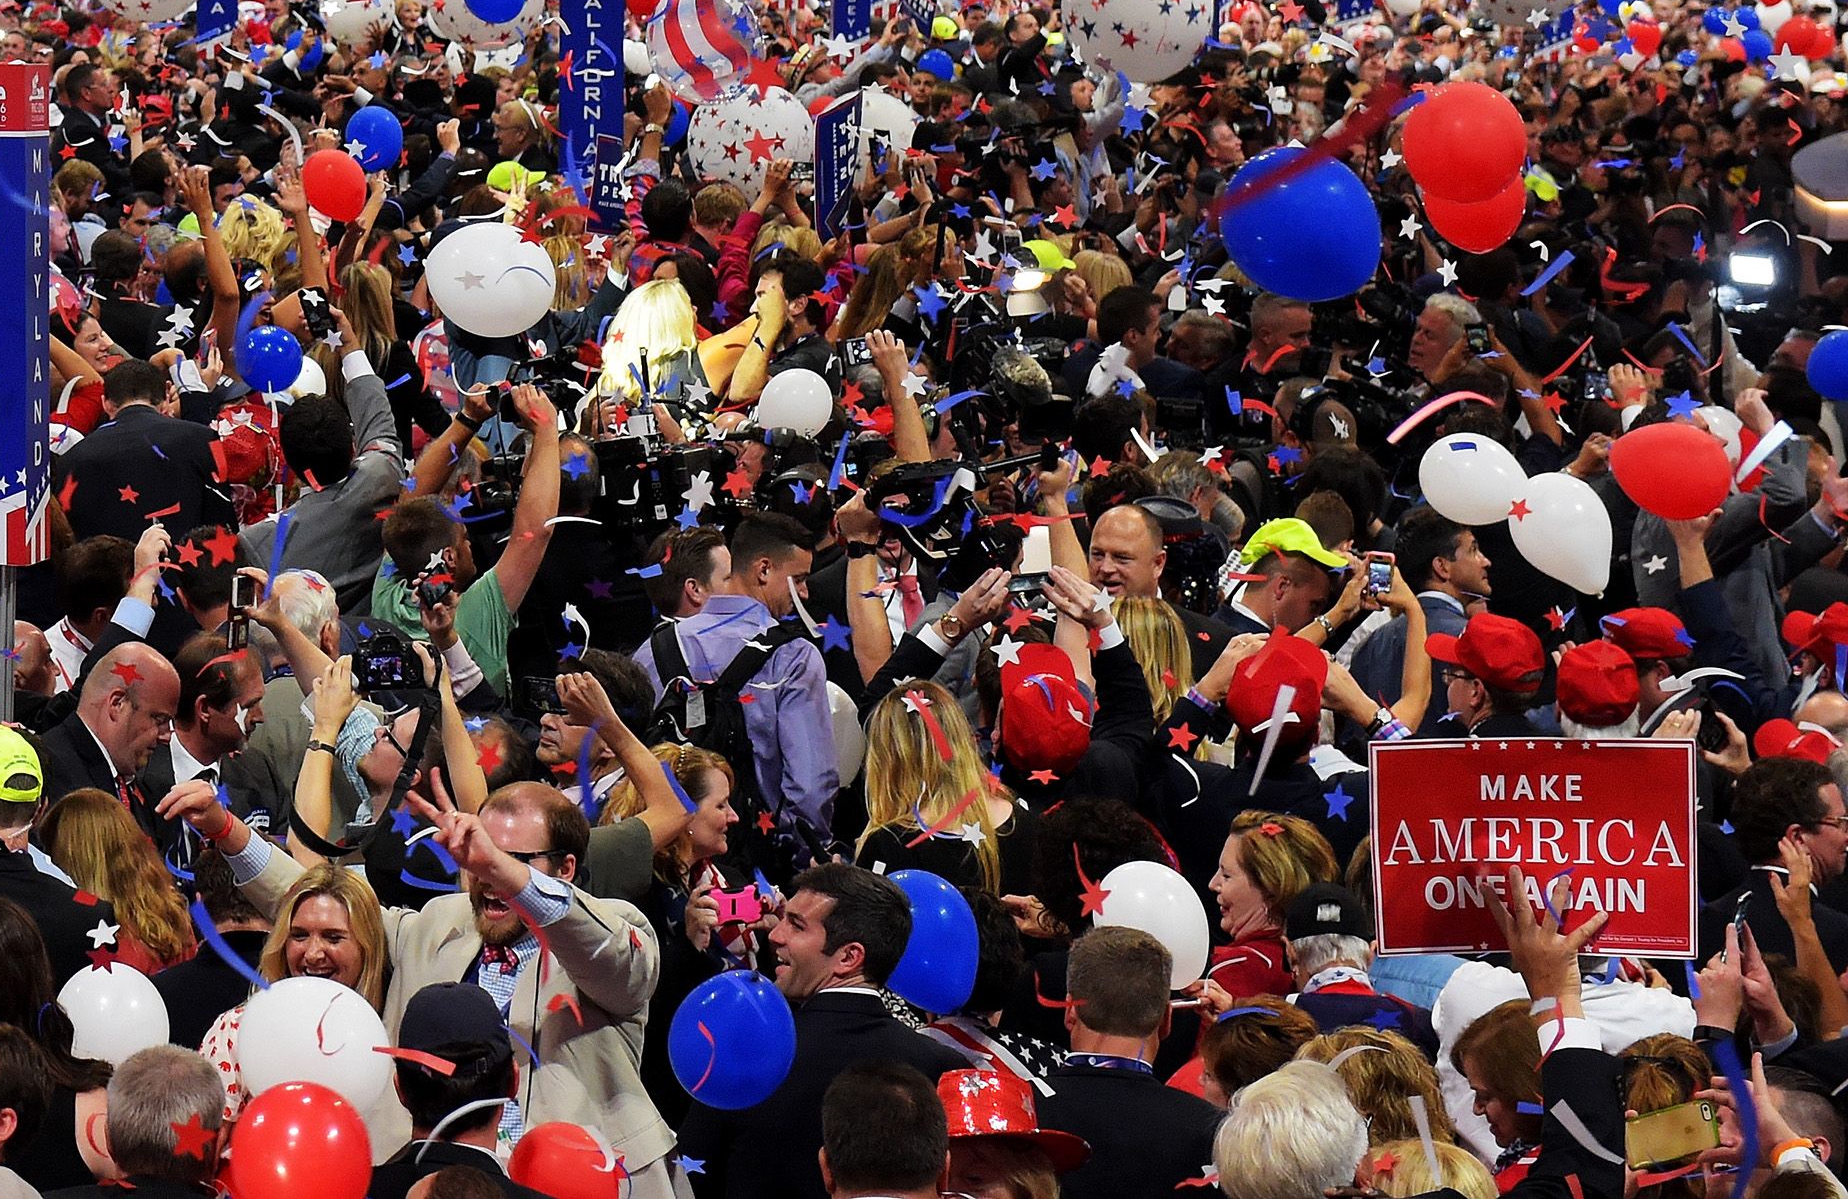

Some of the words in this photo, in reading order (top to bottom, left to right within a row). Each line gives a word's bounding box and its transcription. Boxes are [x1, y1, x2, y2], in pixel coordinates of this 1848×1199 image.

[32, 148, 43, 467] MARYLAND
[1480, 774, 1584, 802] MAKE
[1383, 817, 1686, 868] AMERICA
[1424, 875, 1506, 910] ONE
[1521, 876, 1646, 914] AGAIN
